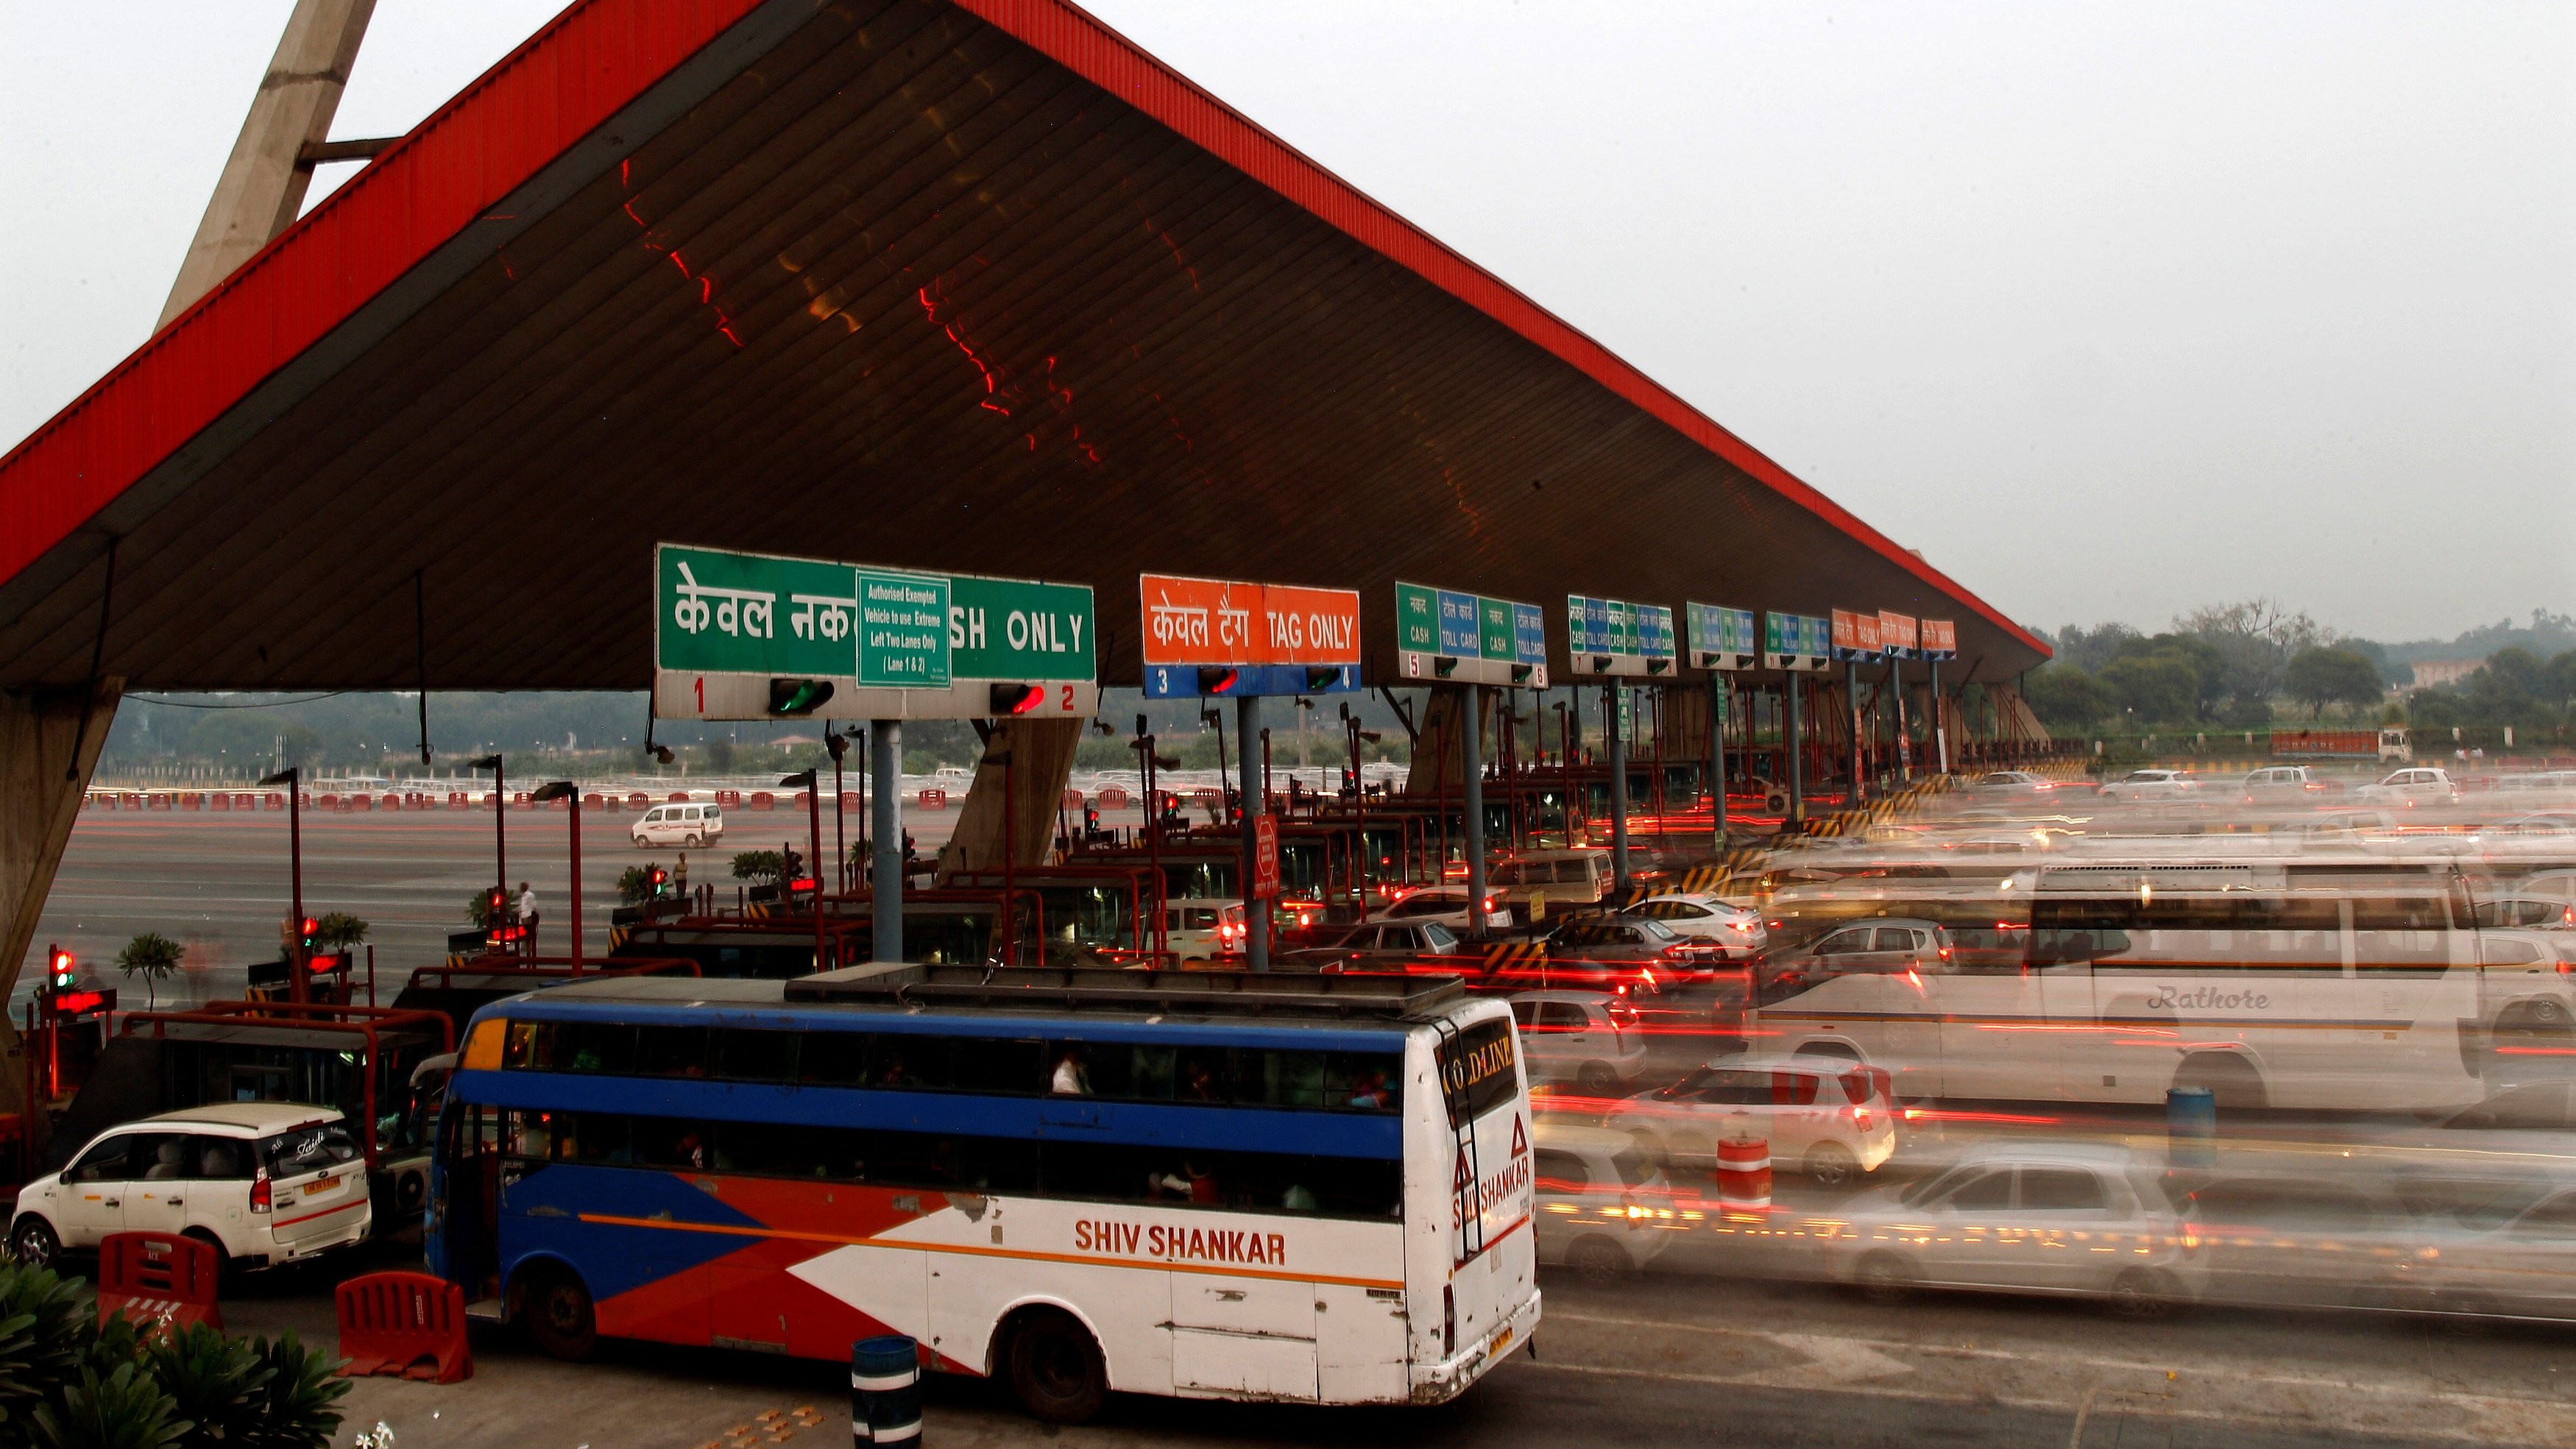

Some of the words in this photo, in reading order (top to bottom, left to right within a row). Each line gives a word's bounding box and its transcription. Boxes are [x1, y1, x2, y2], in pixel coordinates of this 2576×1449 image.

[674, 561, 776, 640] केवल
[791, 594, 856, 642] नक
[868, 584, 904, 601] Authorised
[906, 587, 936, 606] Exempted
[865, 607, 890, 623] Vehicle
[891, 609, 899, 624] to
[899, 614, 911, 626] use
[915, 611, 940, 627] Extreme
[1150, 589, 1208, 646] केवल
[871, 631, 884, 647] Left
[886, 632, 899, 648] Two
[901, 633, 921, 649] Lanes
[922, 634, 937, 653] Only
[950, 607, 986, 649] SH
[1007, 610, 1082, 653] ONLY
[1267, 612, 1303, 648] TAG
[1309, 613, 1353, 649] ONLY
[1410, 626, 1429, 643] CASH
[1443, 631, 1457, 647] TOLL
[1460, 633, 1477, 649] CARD
[1490, 636, 1506, 653] CASH
[1518, 640, 1531, 654] TOLL
[1531, 641, 1545, 656] CARD
[905, 656, 909, 671] 1
[911, 656, 916, 671] &
[1411, 655, 1418, 677] 5
[1158, 669, 1168, 694] 3
[1343, 666, 1350, 689] 4
[694, 678, 704, 713] 1
[1062, 686, 1074, 710] 2
[2147, 985, 2270, 1009] Rathore
[1443, 1052, 1481, 1097] OD
[1481, 1156, 1529, 1214] SHANKAR
[1075, 1220, 1141, 1255] SHIV
[1148, 1225, 1285, 1266] SHANKAR
